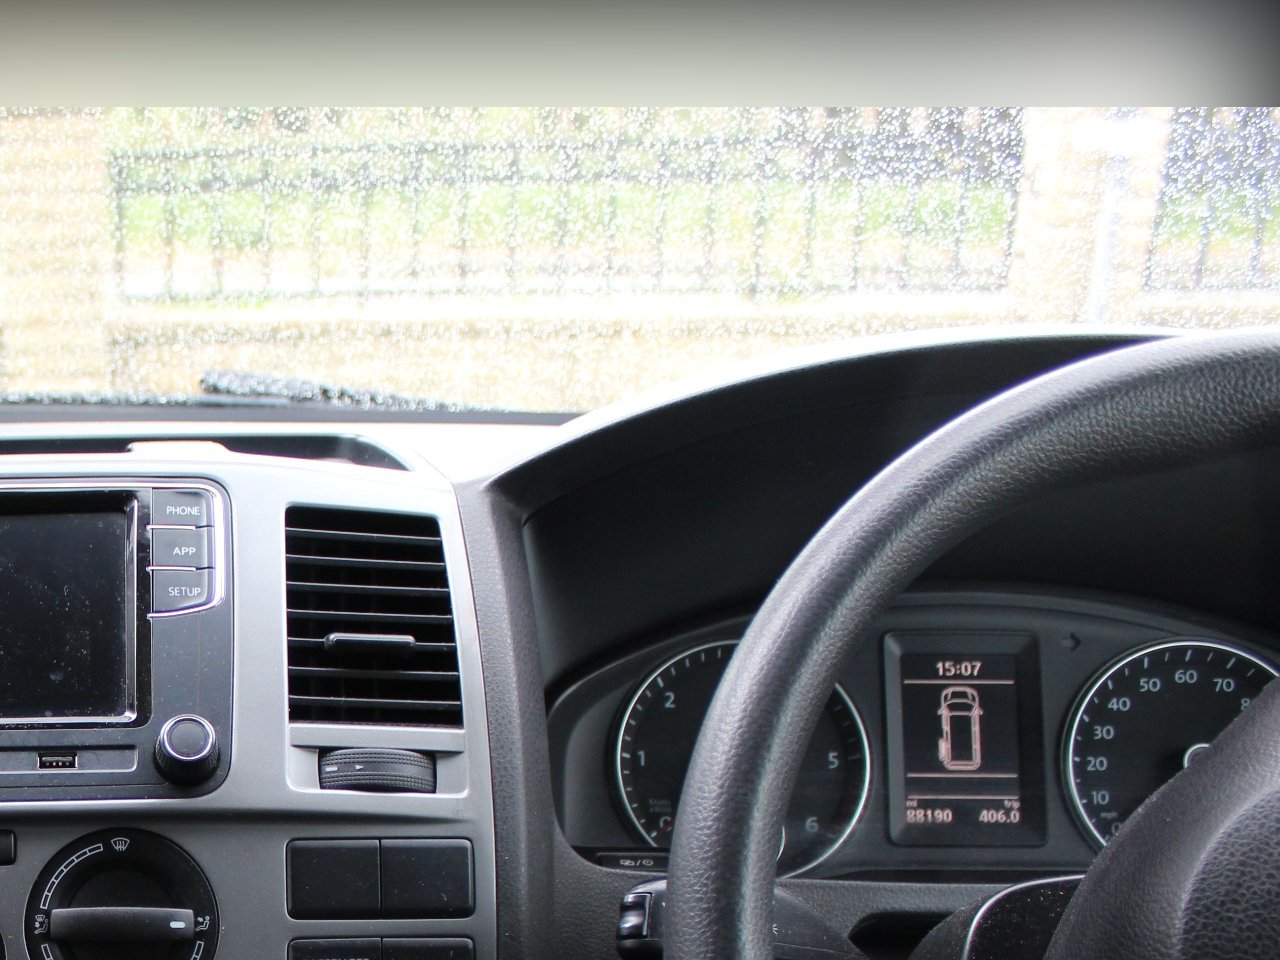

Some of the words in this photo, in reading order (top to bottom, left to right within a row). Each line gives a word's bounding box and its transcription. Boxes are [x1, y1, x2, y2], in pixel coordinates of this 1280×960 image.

[166, 506, 200, 516] PHONE
[173, 547, 196, 556] APP
[168, 587, 201, 597] SETUP
[936, 661, 981, 676] 15:07
[1174, 669, 1197, 684] 60
[1139, 678, 1161, 692] 50
[1213, 678, 1235, 692] 70
[664, 692, 676, 708] 2
[1107, 697, 1131, 712] 40
[1093, 725, 1115, 740] 30
[637, 751, 646, 766] 1
[828, 752, 839, 769] 5
[1086, 756, 1108, 771] 20
[1091, 790, 1110, 805] 10
[979, 809, 1020, 823] 406.0
[805, 816, 818, 832] 6
